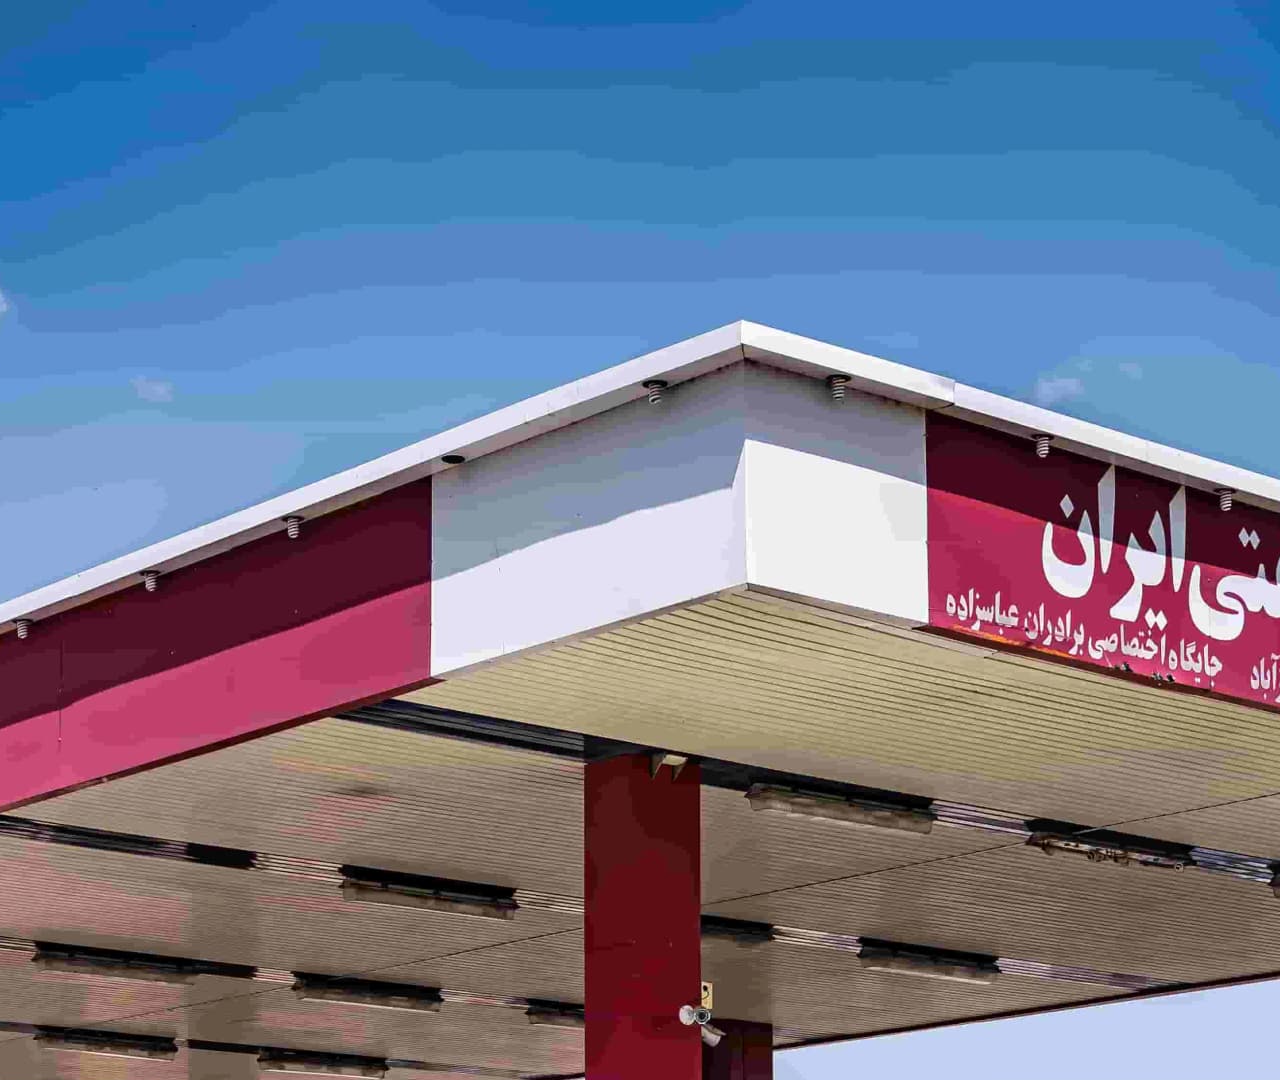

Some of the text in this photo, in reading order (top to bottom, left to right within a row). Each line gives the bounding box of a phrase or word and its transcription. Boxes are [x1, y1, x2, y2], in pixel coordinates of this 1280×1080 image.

[1041, 464, 1186, 631] ایران
[1024, 602, 1085, 656] برادران
[1088, 623, 1167, 665] اختصاصی
[1168, 638, 1223, 687] جایگاه
